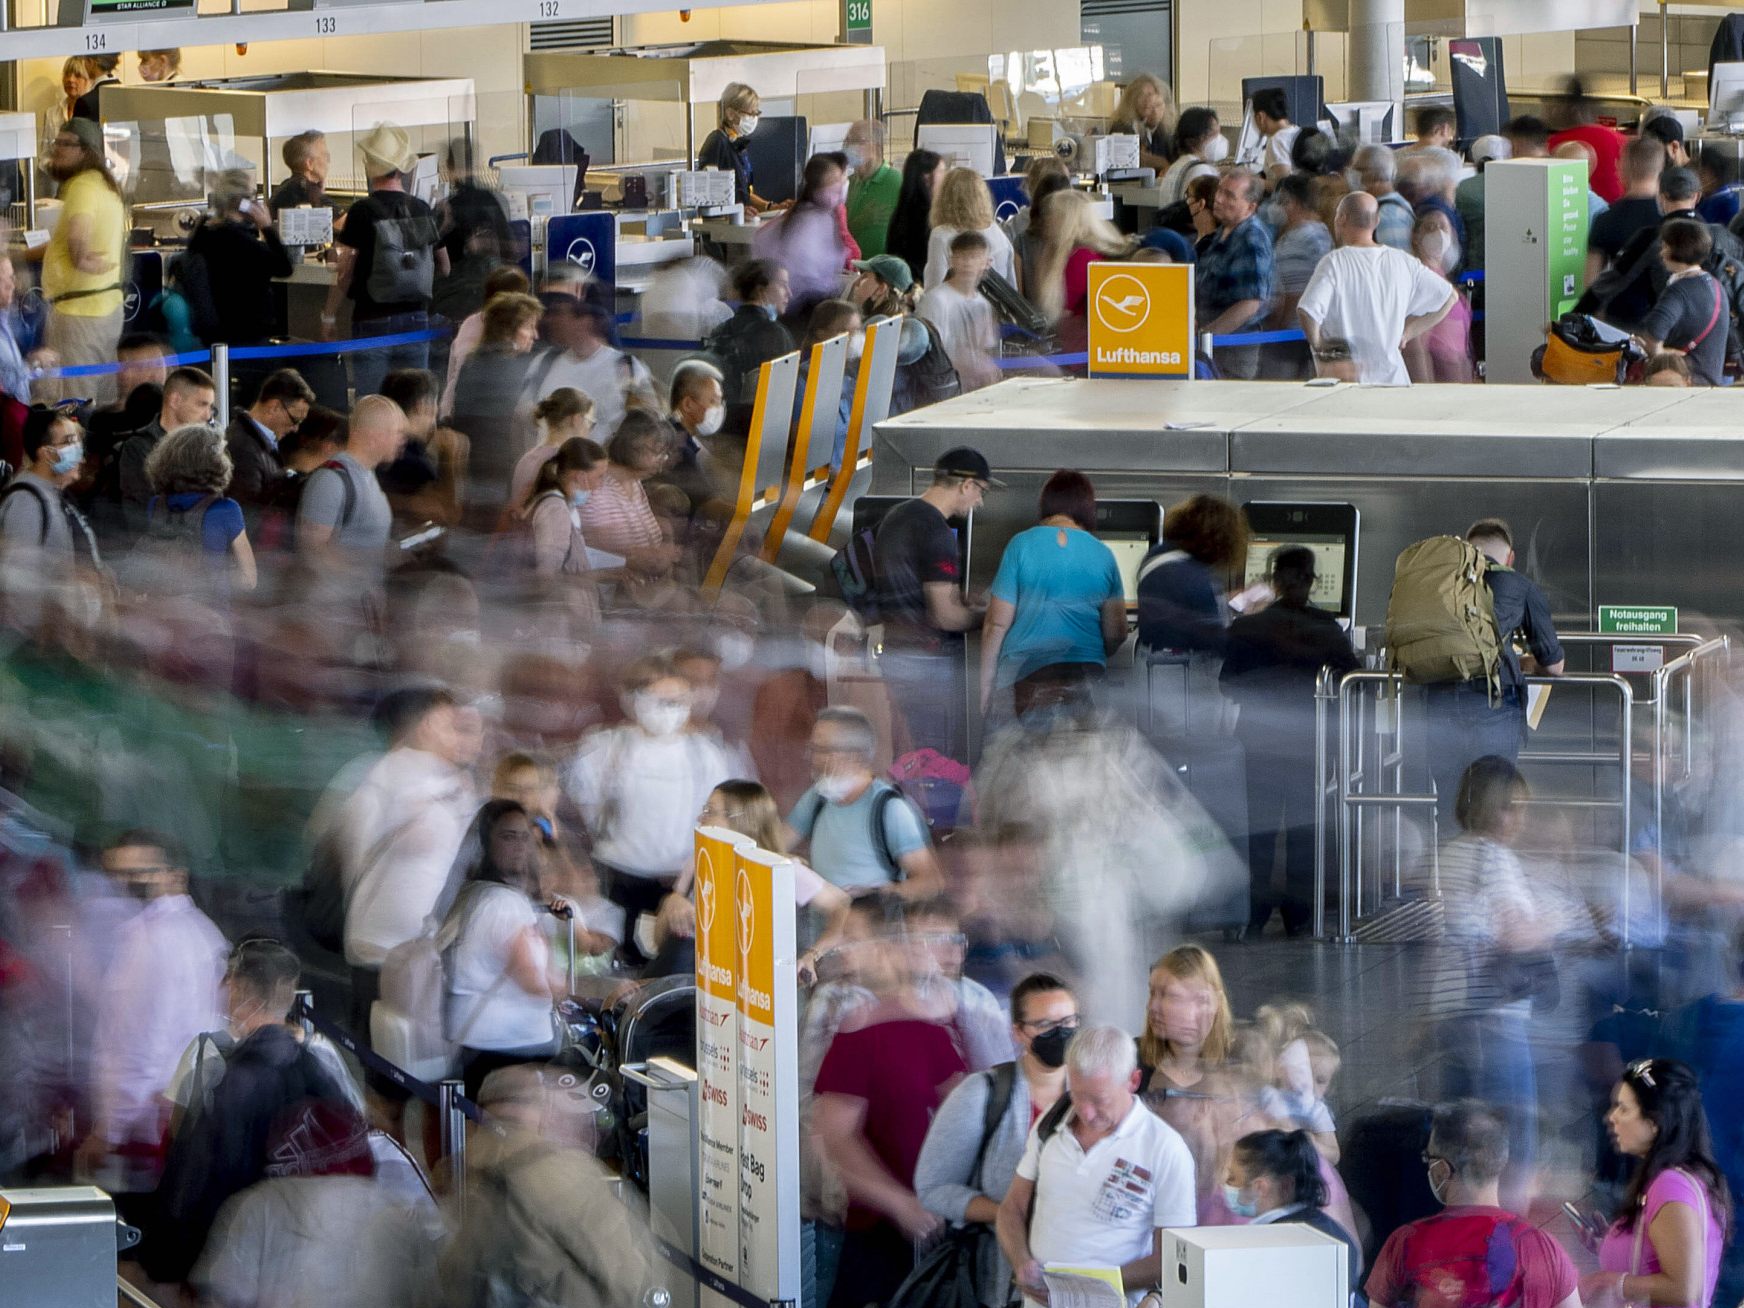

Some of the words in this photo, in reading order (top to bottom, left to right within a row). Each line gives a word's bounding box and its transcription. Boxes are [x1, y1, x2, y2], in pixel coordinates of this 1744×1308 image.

[539, 0, 559, 17] 132
[848, 2, 870, 21] 316
[315, 17, 336, 34] 133
[85, 34, 106, 50] 134
[1097, 346, 1181, 364] Lufthansa
[1609, 609, 1668, 622] Notausgang
[1615, 621, 1662, 632] freihalten
[747, 1108, 767, 1132] SWISS
[750, 1152, 765, 1183] Bag
